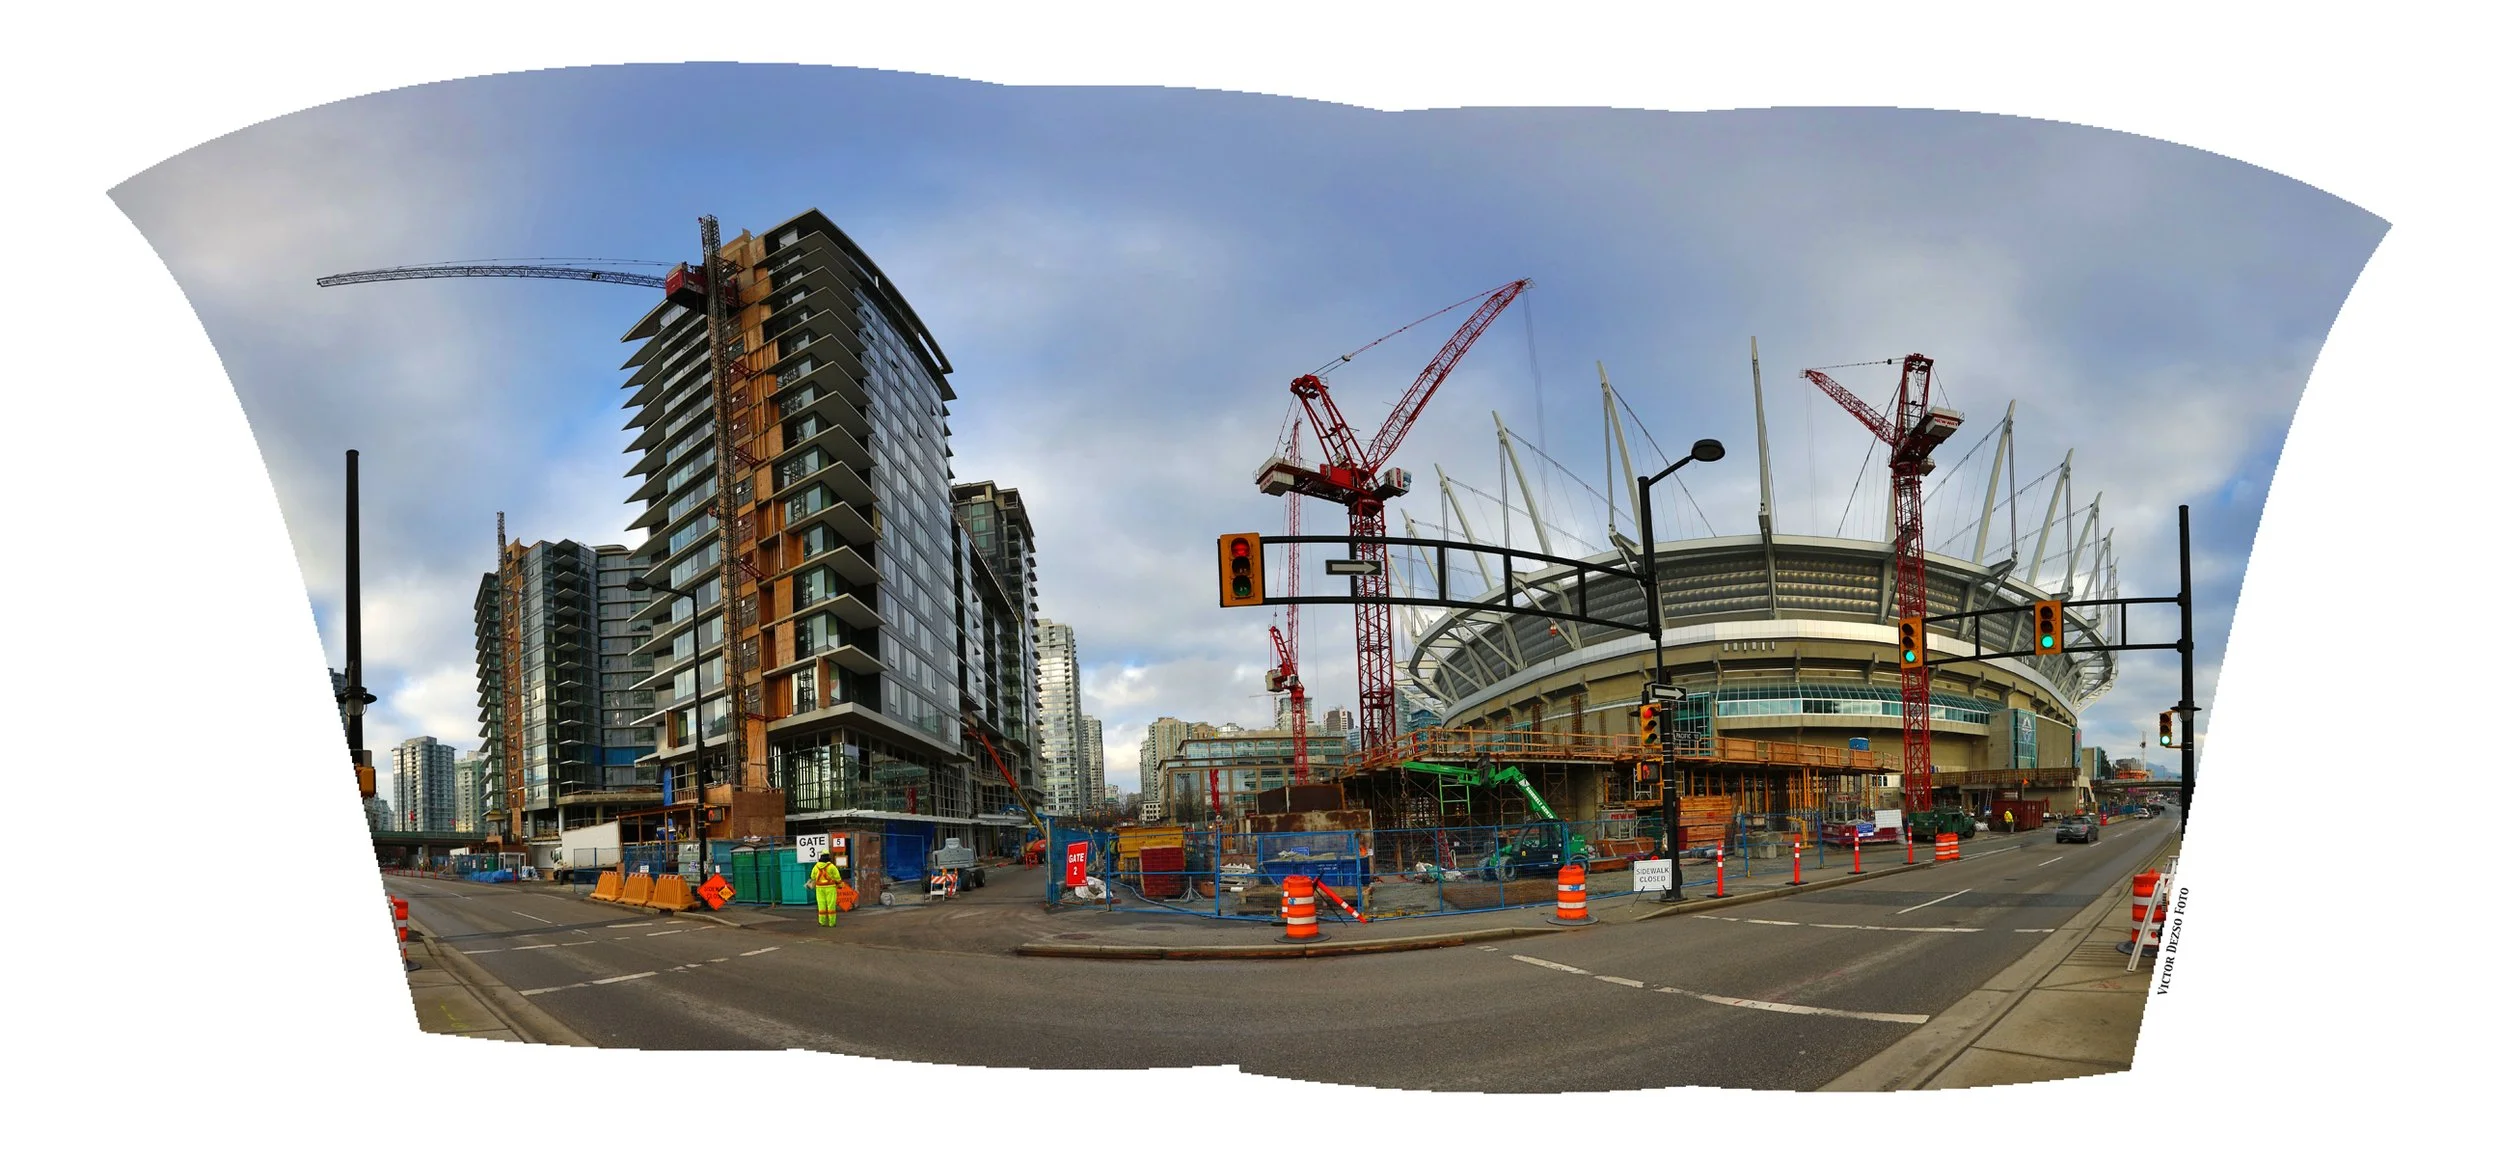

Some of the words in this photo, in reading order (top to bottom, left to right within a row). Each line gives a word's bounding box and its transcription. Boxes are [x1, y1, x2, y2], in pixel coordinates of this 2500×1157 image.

[800, 837, 825, 846] GATE
[809, 847, 815, 858] 3
[1069, 852, 1084, 863] GATE
[1073, 866, 1078, 875] 2
[1636, 867, 1669, 875] SIDEWALK
[1639, 875, 1666, 883] CLOSED
